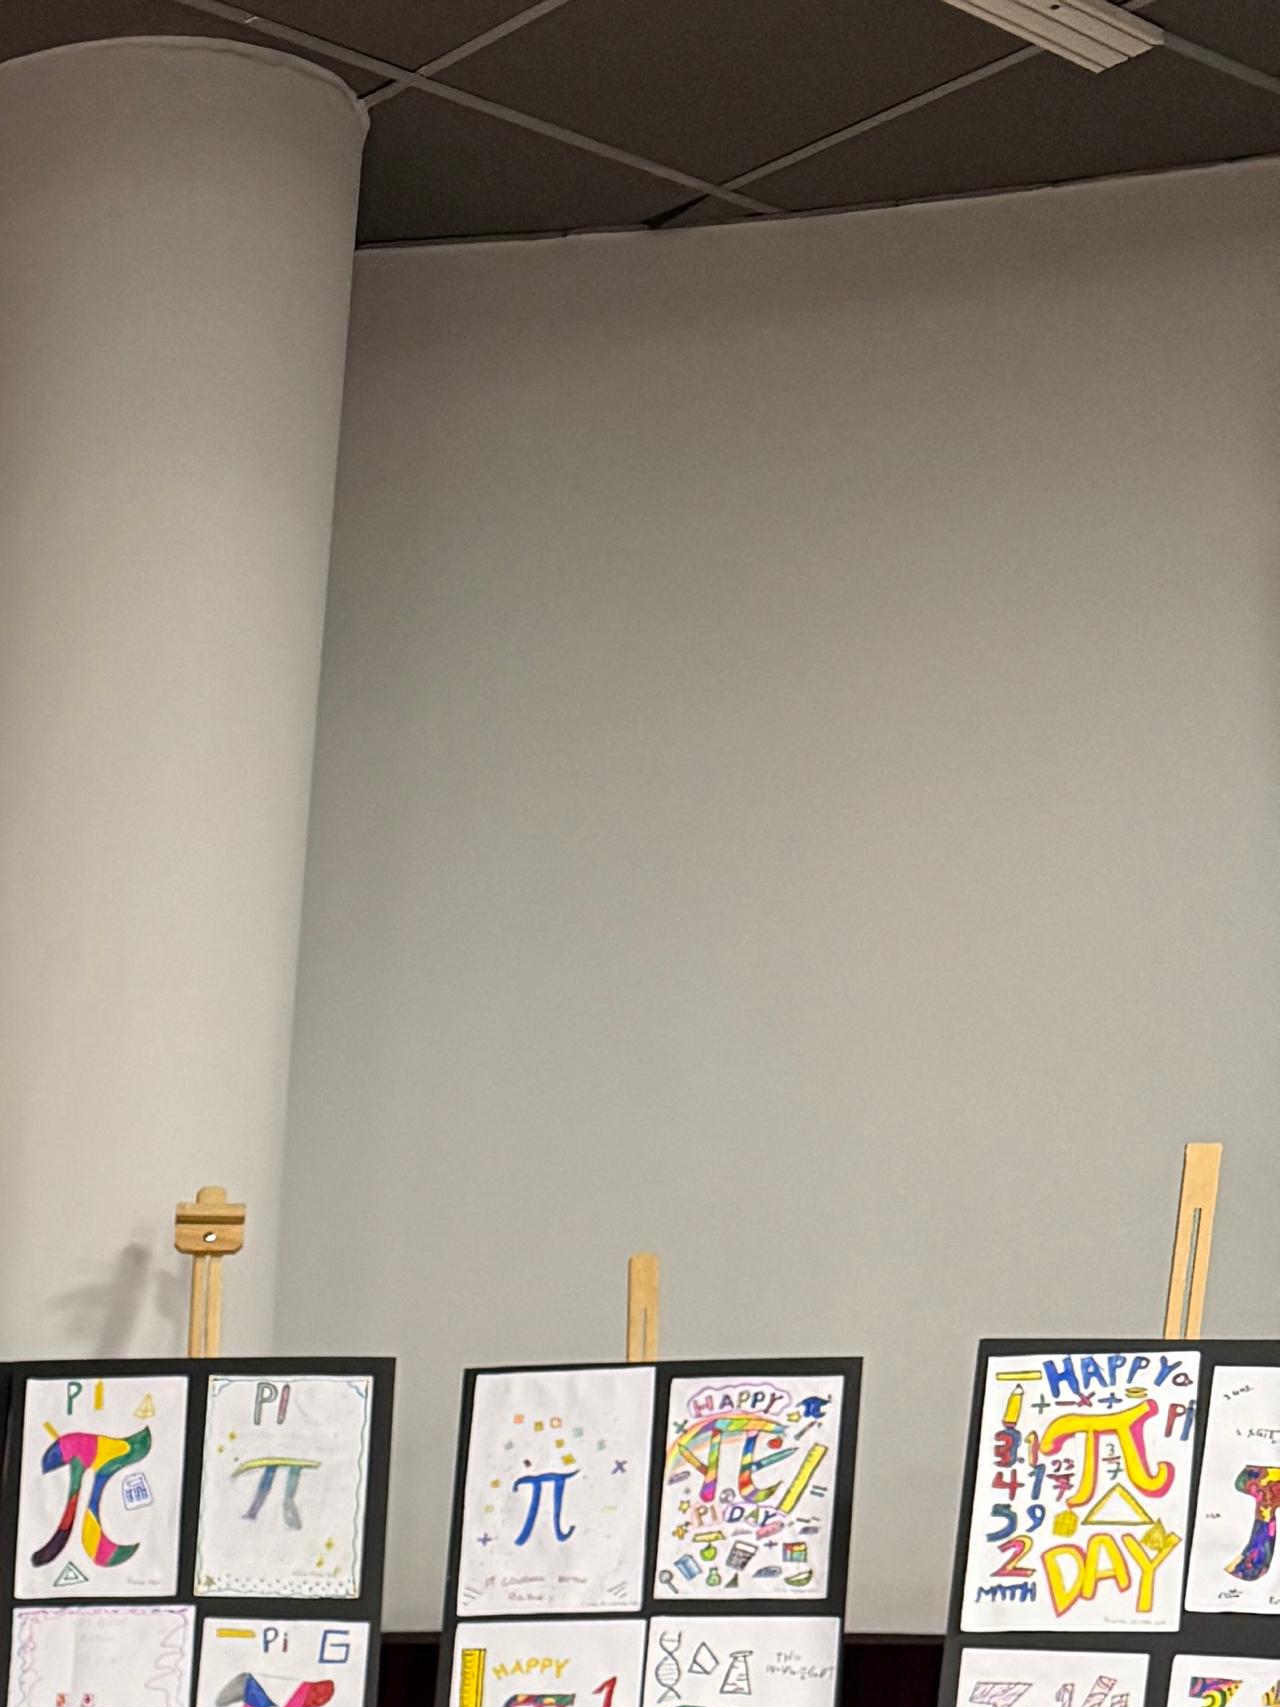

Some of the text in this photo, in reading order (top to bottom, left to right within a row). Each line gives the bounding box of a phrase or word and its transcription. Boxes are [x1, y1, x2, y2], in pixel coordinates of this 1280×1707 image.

[1042, 1354, 1183, 1398] HAPPY
[692, 1391, 783, 1417] HAPPY
[728, 1507, 777, 1526] DAY
[1041, 1532, 1182, 1618] DAY
[492, 1658, 570, 1679] HAPPY
